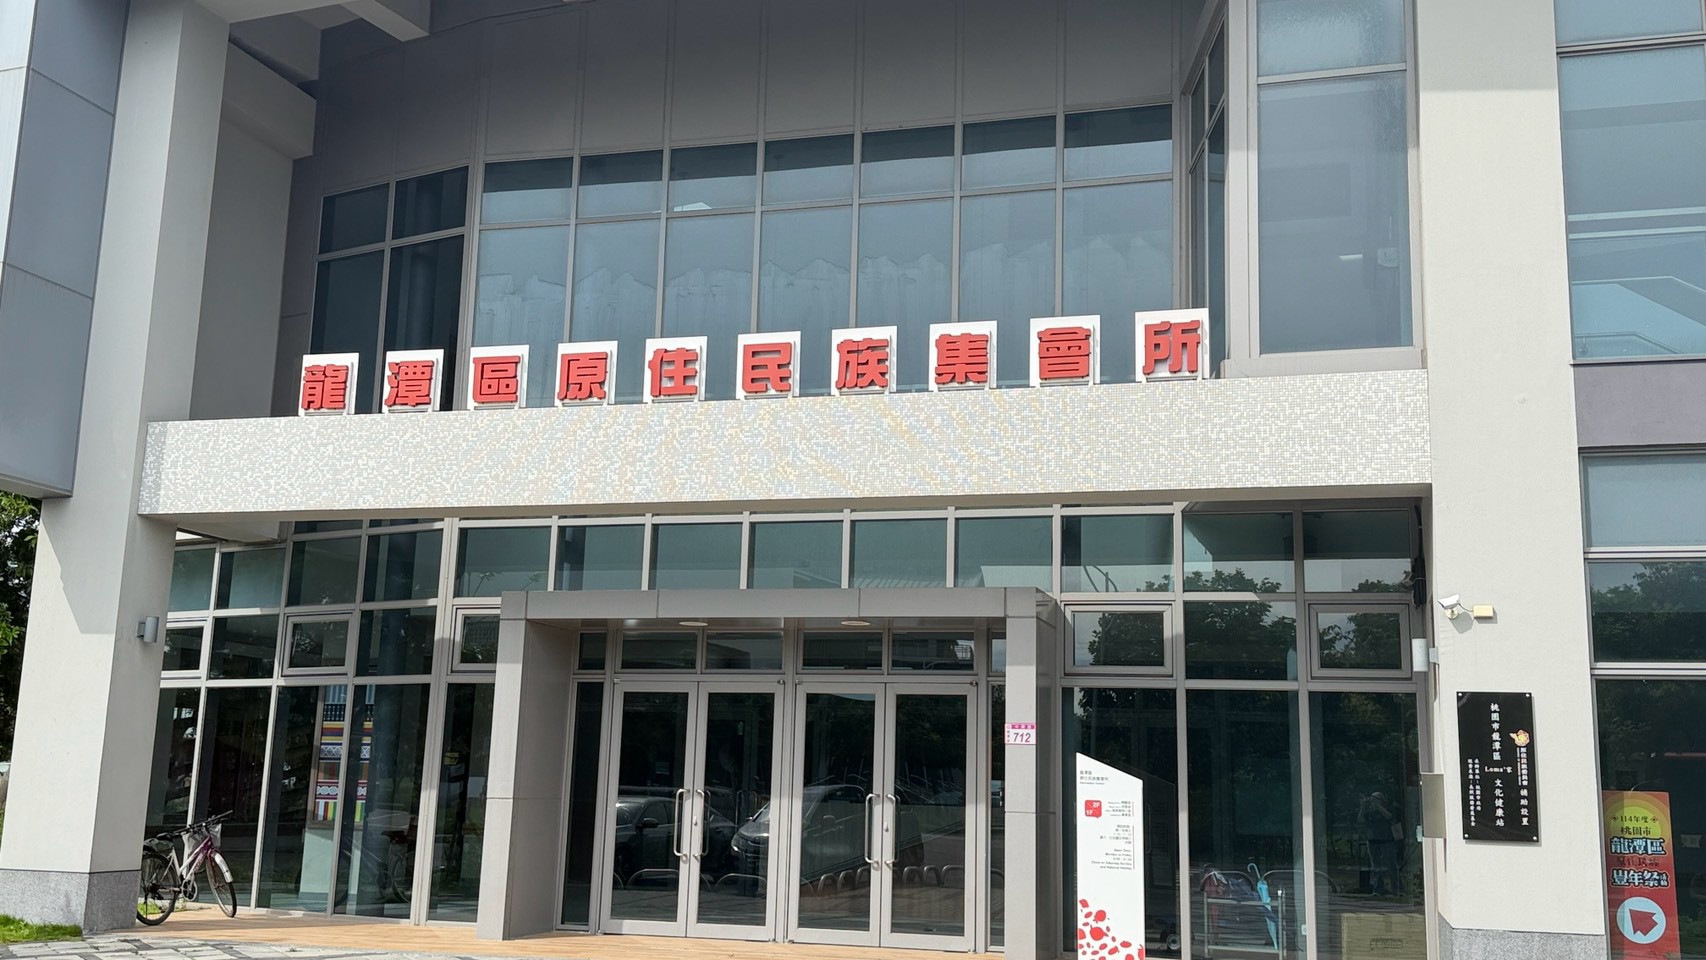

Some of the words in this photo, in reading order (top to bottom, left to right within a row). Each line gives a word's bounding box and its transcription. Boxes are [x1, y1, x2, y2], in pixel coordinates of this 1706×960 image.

[302, 320, 1201, 410] 龍潭區原住民族集會所
[1013, 732, 1031, 743] 712
[1490, 702, 1501, 761] 桃園市龍潭區
[1494, 778, 1505, 827] 文化健康站
[1620, 815, 1649, 823] 114年度
[1620, 826, 1651, 836] 桃園市
[1611, 837, 1666, 855] 龍潭區
